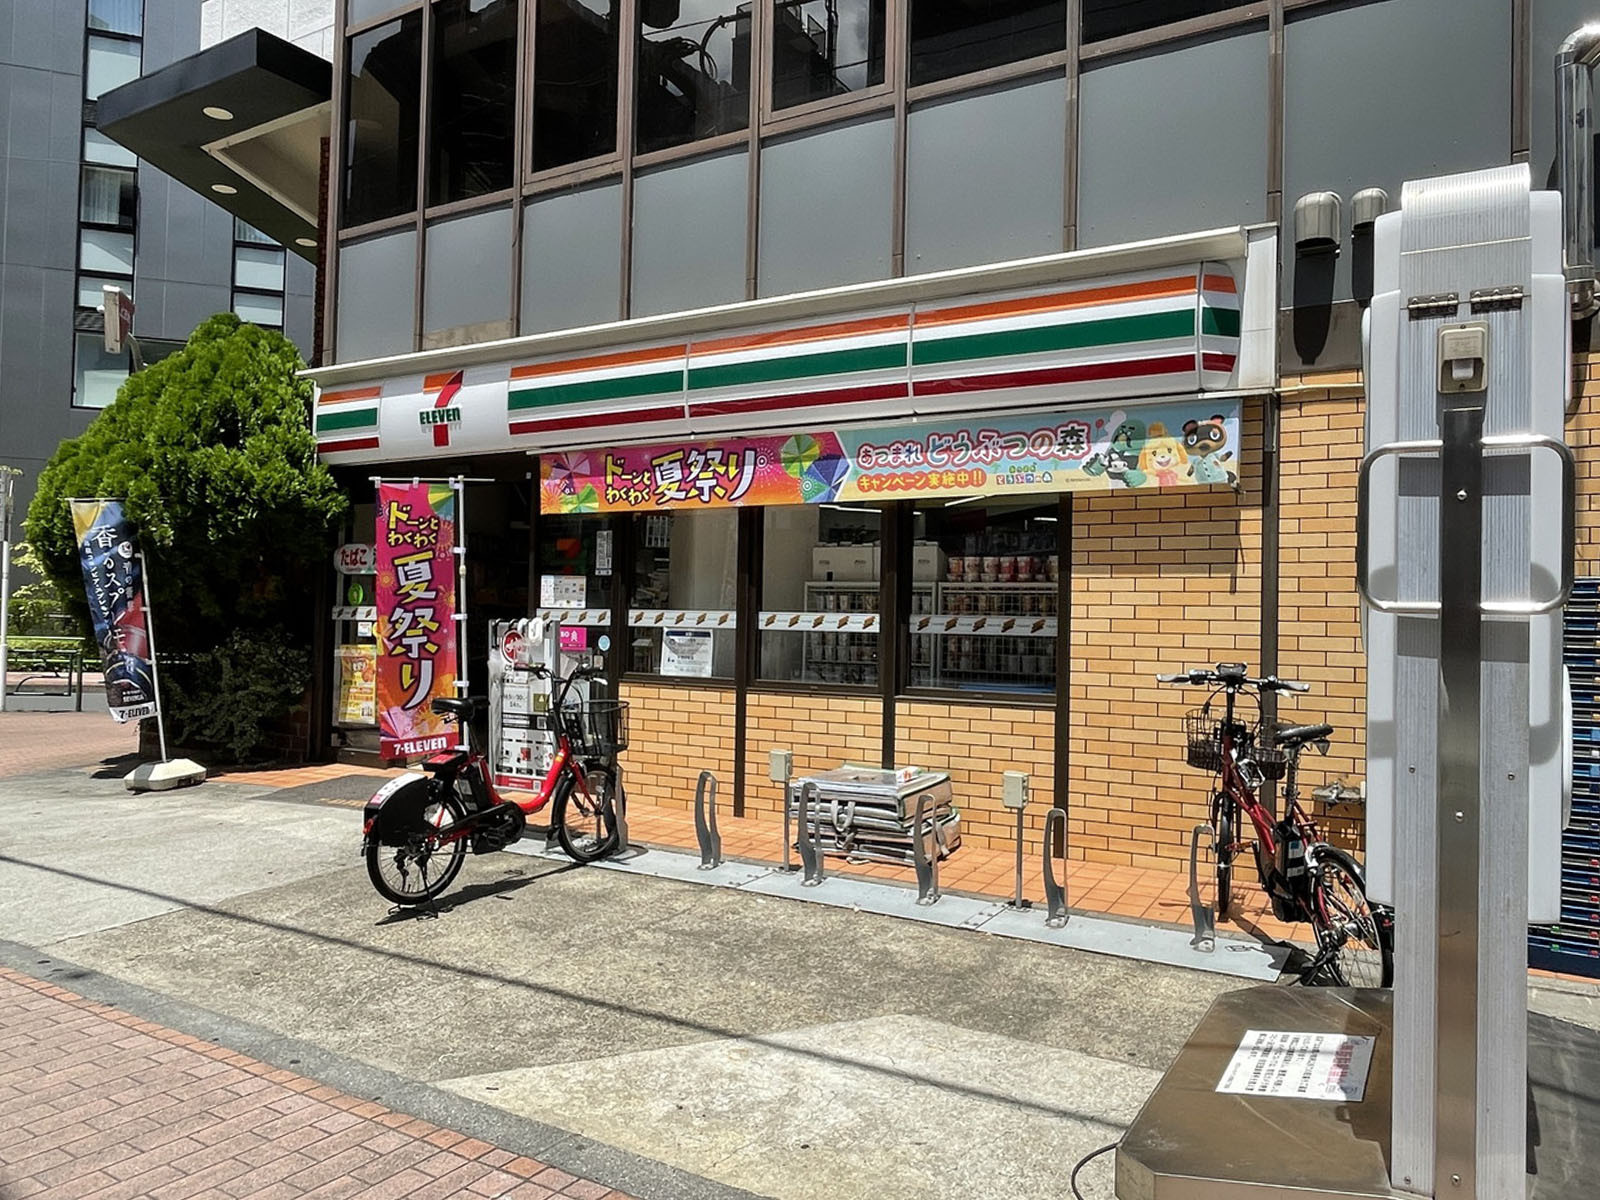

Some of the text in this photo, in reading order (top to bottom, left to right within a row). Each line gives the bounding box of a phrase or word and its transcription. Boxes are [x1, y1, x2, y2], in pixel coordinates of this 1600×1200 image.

[857, 446, 924, 467] あつまれ
[605, 455, 652, 485] ドーンと
[652, 448, 758, 503] 夏祭り
[605, 485, 652, 505] わくわく
[387, 501, 440, 531] ドーンと
[387, 530, 438, 549] わくわく
[340, 548, 367, 566] たばこ
[389, 549, 441, 711] 夏祭り
